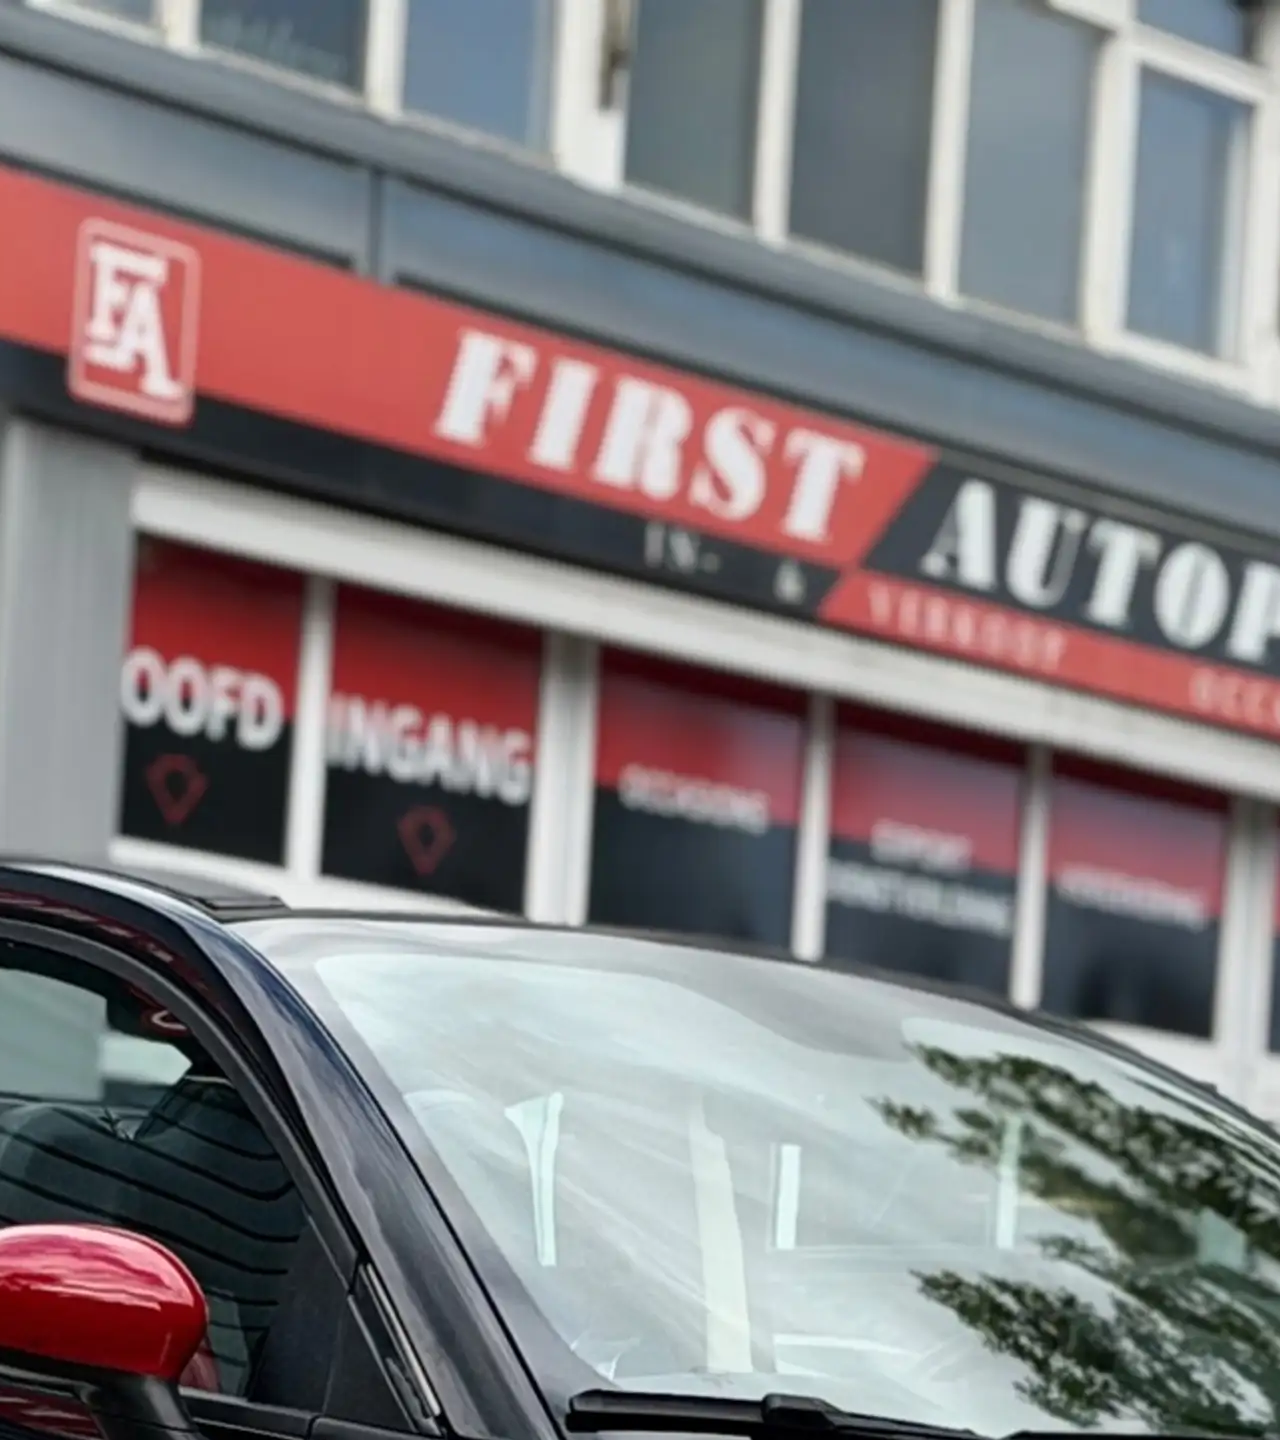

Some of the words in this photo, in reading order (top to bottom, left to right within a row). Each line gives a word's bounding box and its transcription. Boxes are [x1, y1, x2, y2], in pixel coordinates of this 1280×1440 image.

[433, 324, 868, 544] FIRST
[119, 646, 285, 751] OOFD
[326, 692, 533, 807] INGANG
